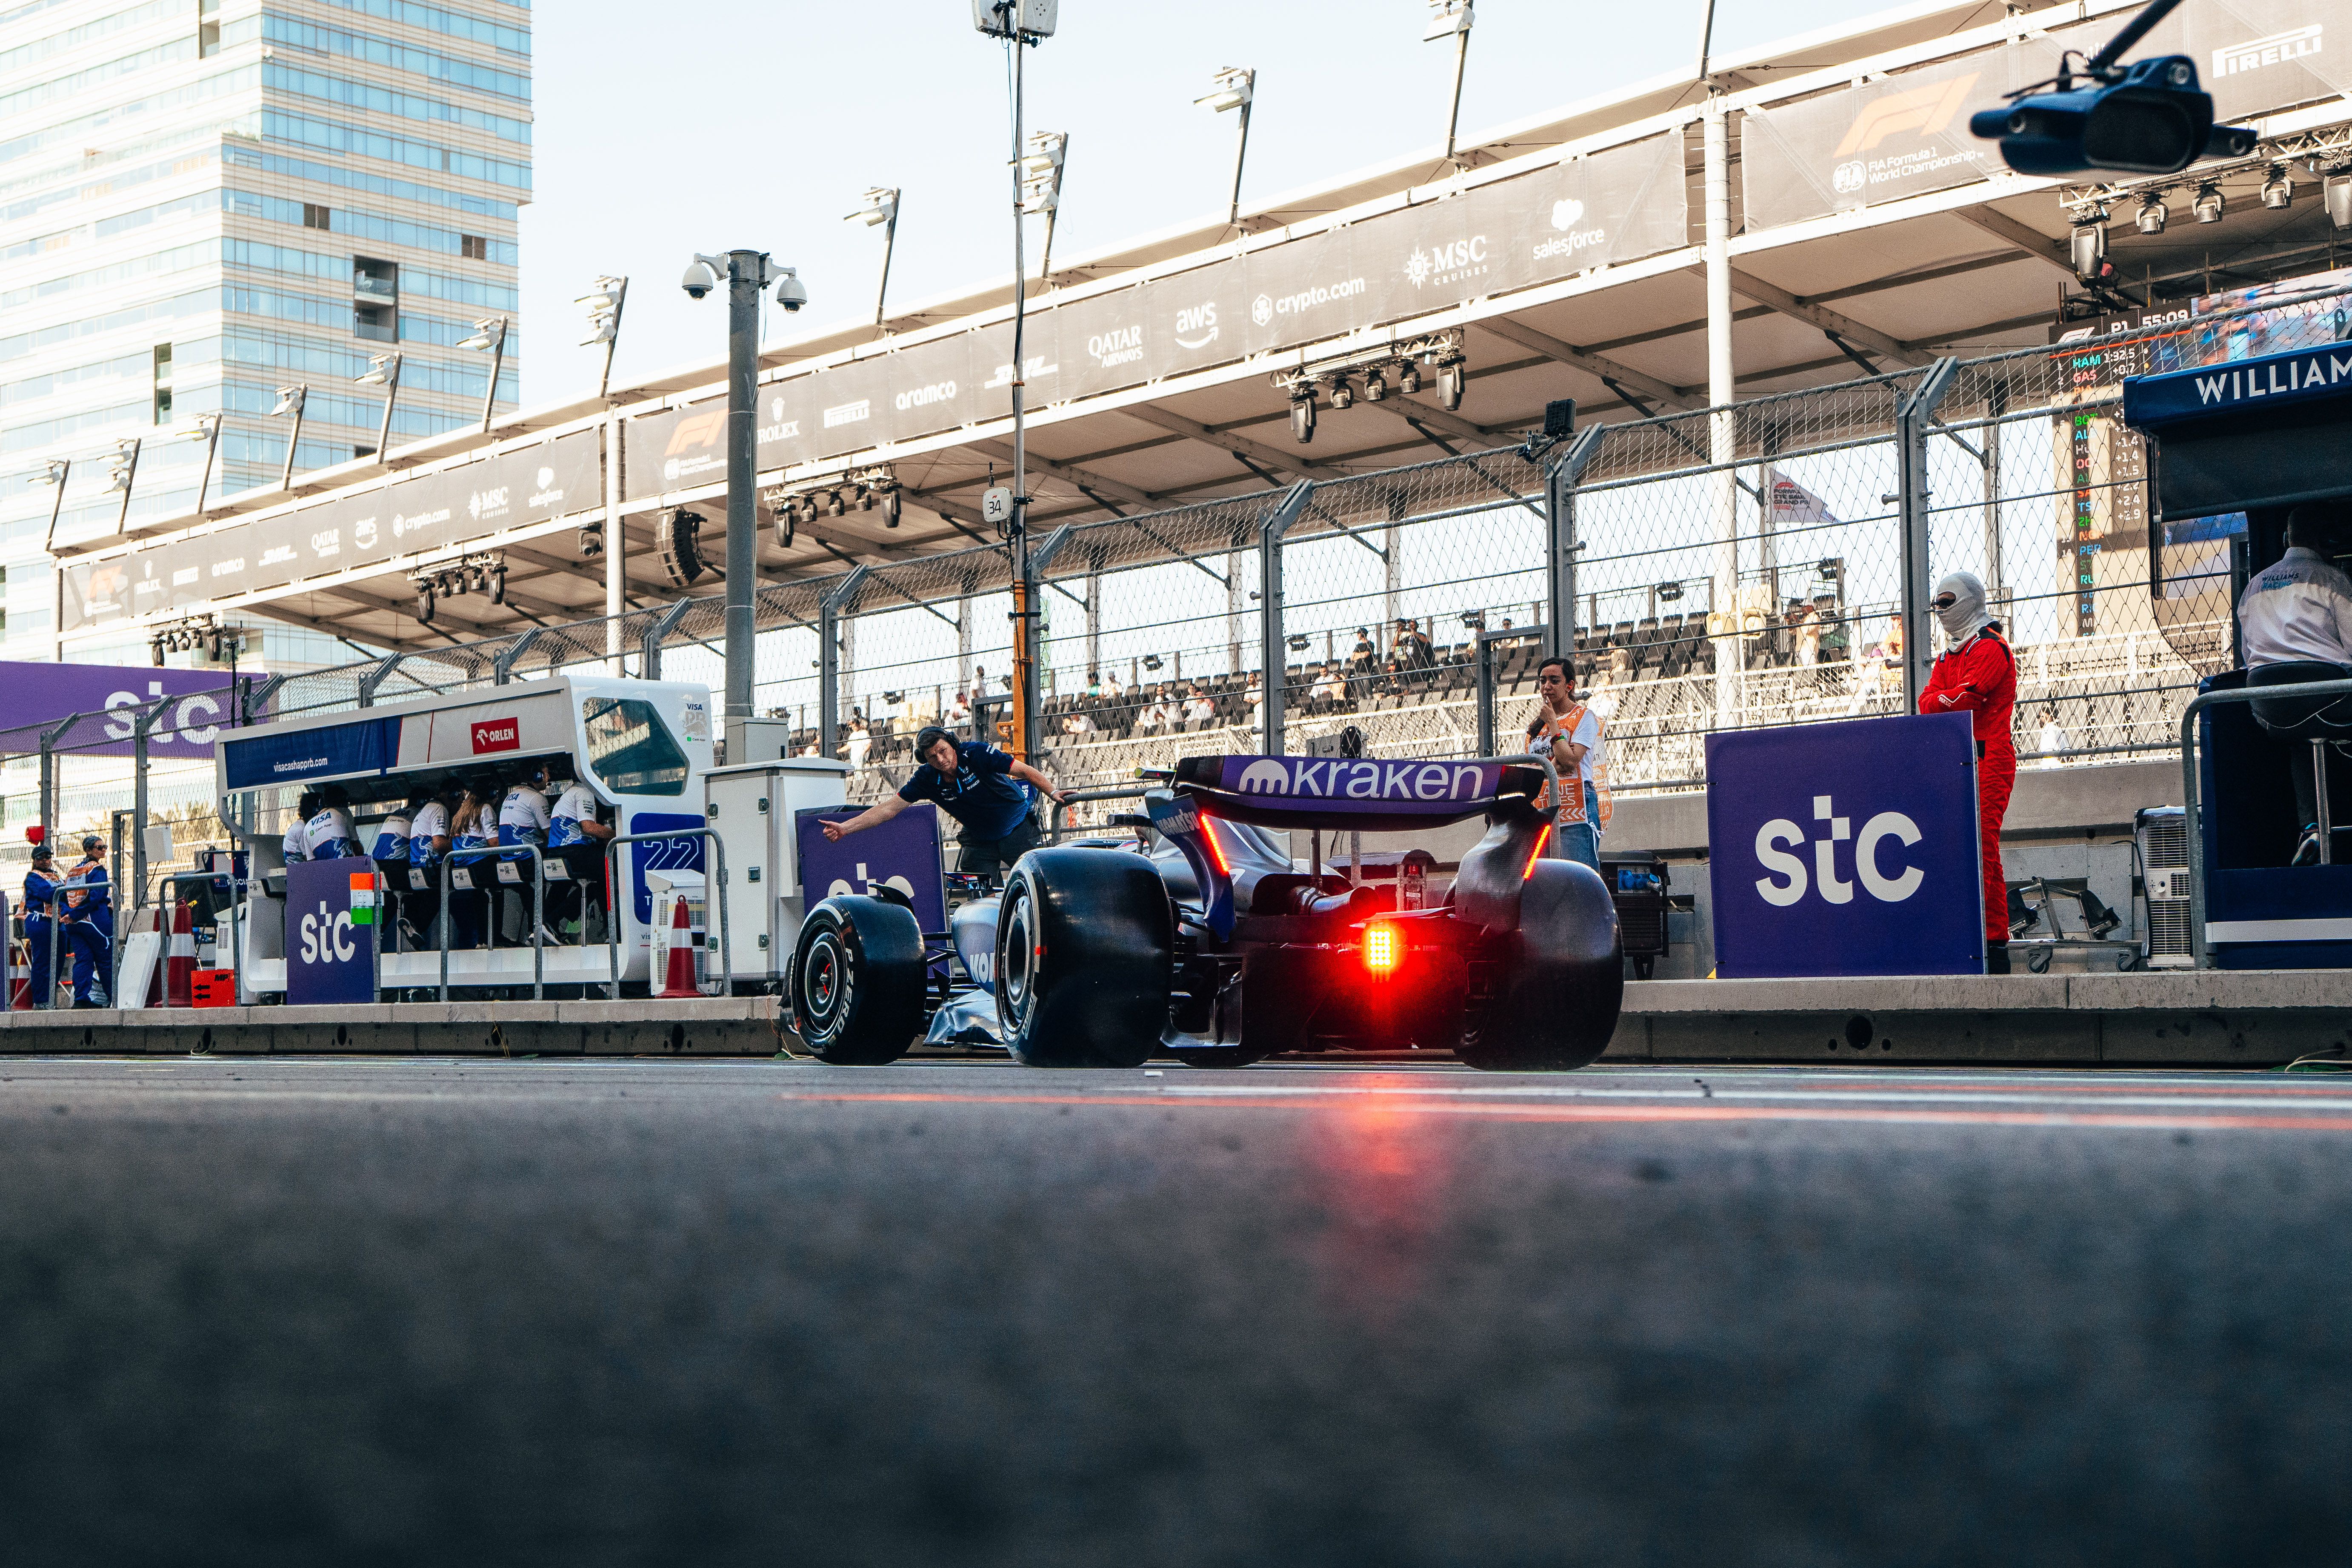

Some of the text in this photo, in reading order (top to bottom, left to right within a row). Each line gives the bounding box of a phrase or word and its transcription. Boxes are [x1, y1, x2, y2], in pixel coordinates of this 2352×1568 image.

[2212, 23, 2323, 79] PIRELLI
[1868, 146, 1937, 172] FIA Formula 1
[1869, 170, 1899, 184] World
[1901, 150, 1975, 176] Championship
[1432, 235, 1487, 273] MSC
[1532, 228, 1605, 261] salesforce
[1434, 265, 1488, 286] CRUISES
[1276, 277, 1365, 316] crypto.com
[1176, 302, 1217, 333] aws
[2111, 309, 2188, 334] P1 55:09
[1088, 326, 1142, 360] QATAR
[1101, 346, 1144, 368] AIRWAYS
[2072, 354, 2101, 369] HAM
[2103, 348, 2135, 364] 1:32.5
[2073, 369, 2098, 383] GAS
[895, 381, 957, 411] aramco
[823, 399, 870, 429] PIRELLI
[757, 420, 800, 445] ROLEX
[2116, 465, 2140, 477] +1.5
[482, 486, 509, 511] MSC
[529, 489, 564, 508] salesforce
[988, 500, 1002, 515] 34
[405, 508, 450, 531] crypto.com
[482, 507, 509, 520] CRUISES
[355, 517, 377, 537] aws
[311, 528, 340, 552] QATAR
[212, 557, 245, 577] aramco
[261, 545, 295, 566] DHL
[2261, 573, 2300, 582] WILLIAMS
[2261, 580, 2293, 590] RACING
[104, 681, 220, 745] stc
[489, 728, 514, 743] ORLEN
[274, 757, 328, 773] visacashapprb.com
[1293, 760, 1484, 800] kraken
[506, 793, 520, 802] VISA
[311, 811, 332, 826] VISA
[643, 836, 699, 871] 22
[1755, 795, 1925, 907] stc
[300, 900, 356, 964] stc
